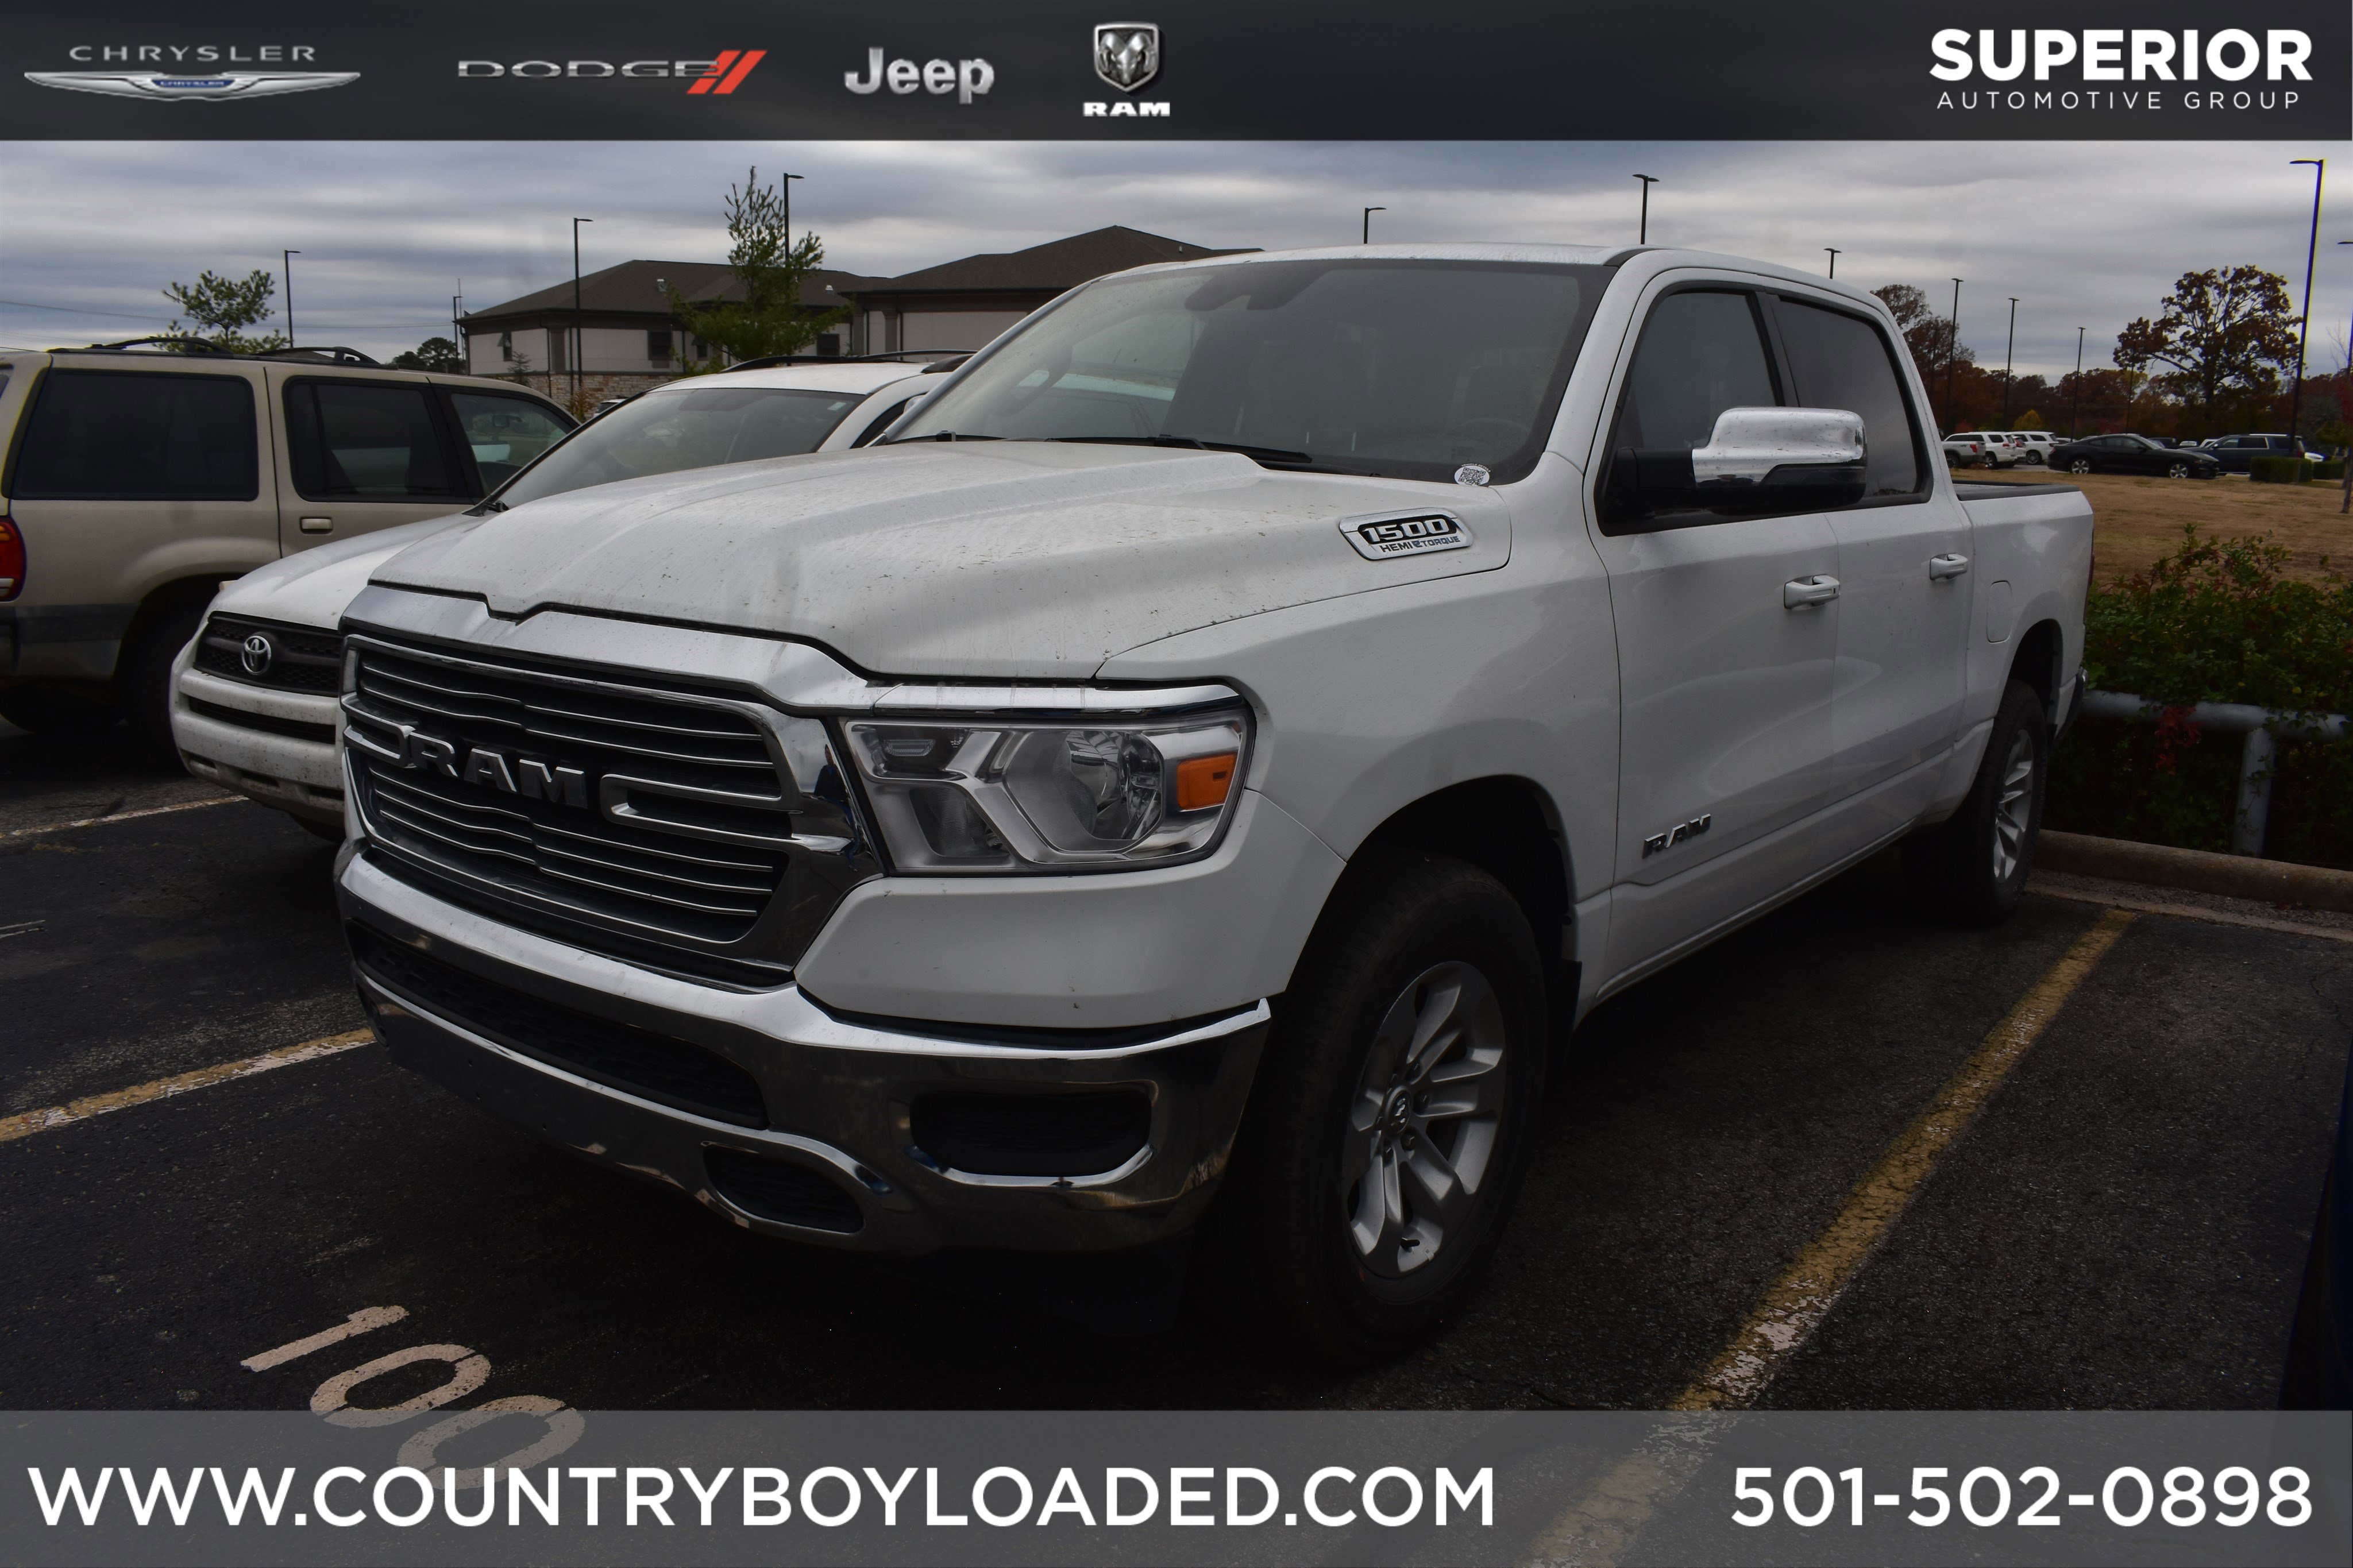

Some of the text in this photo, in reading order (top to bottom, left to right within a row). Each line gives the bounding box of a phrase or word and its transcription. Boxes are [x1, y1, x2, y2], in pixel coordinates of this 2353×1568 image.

[1361, 518, 1449, 542] 1500
[1379, 541, 1414, 553] HEMI
[409, 732, 589, 809] RAM
[1641, 813, 1711, 859] RAM
[240, 1304, 585, 1491] 100
